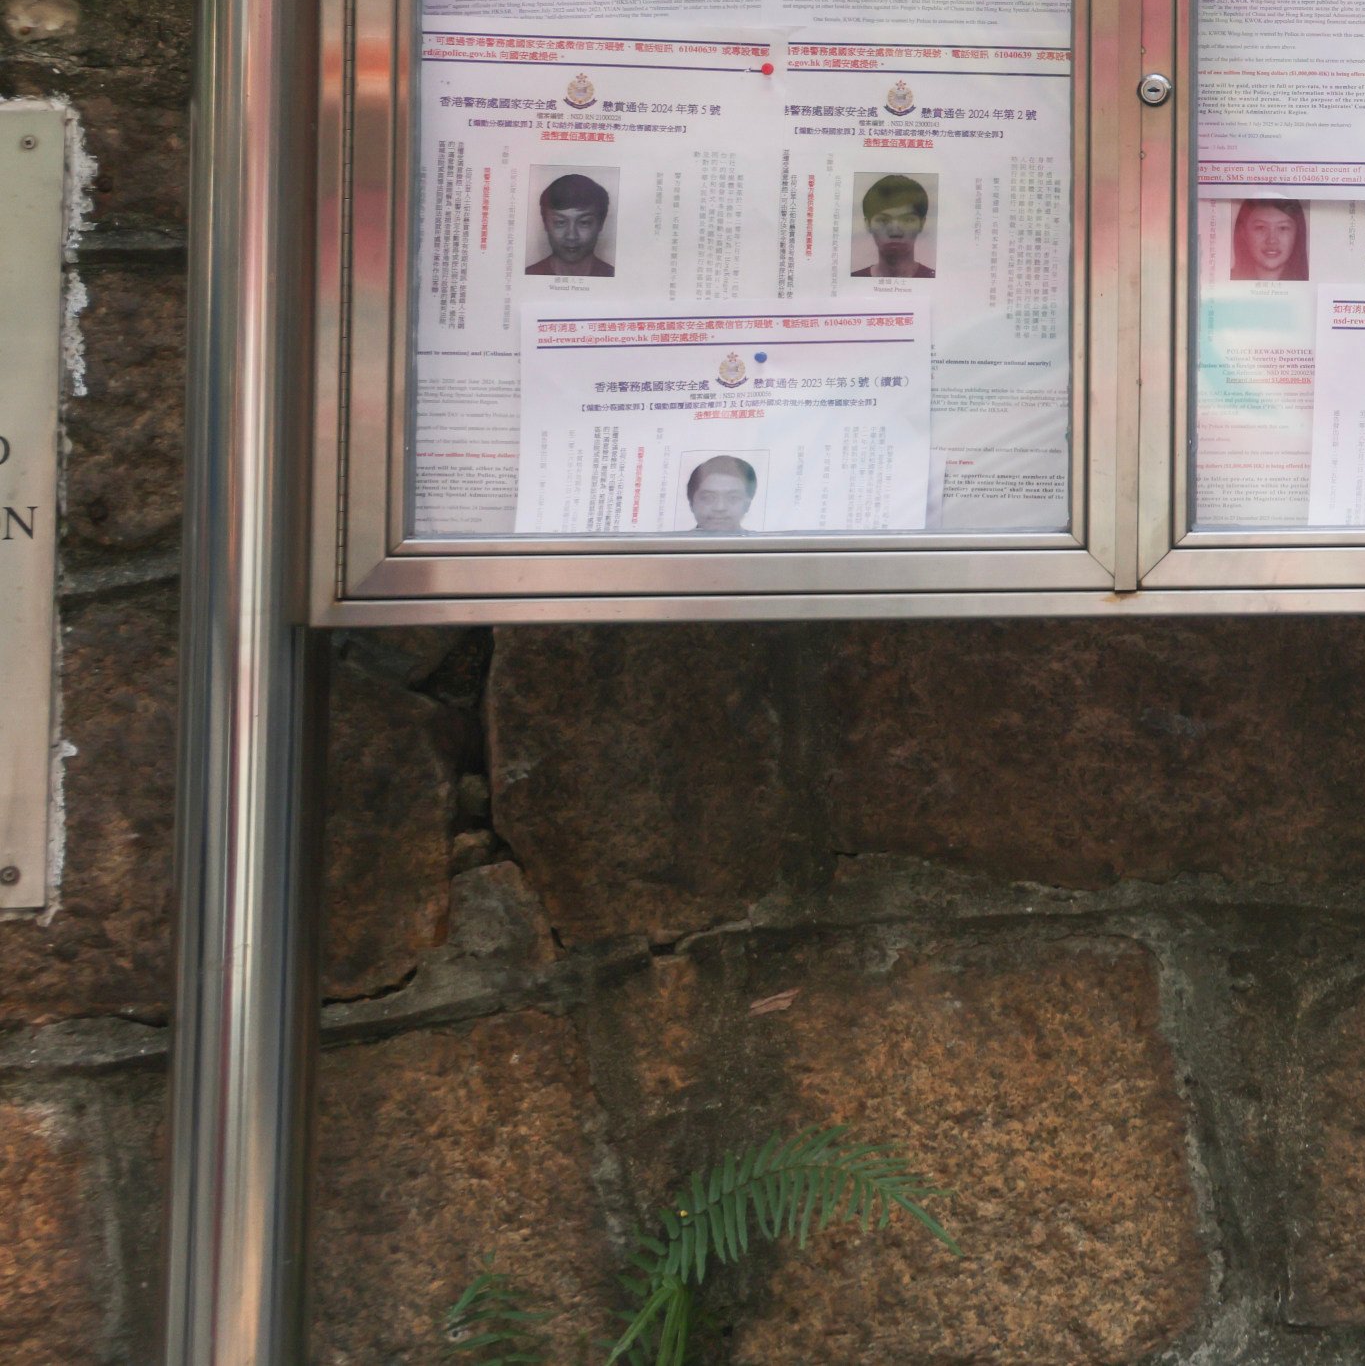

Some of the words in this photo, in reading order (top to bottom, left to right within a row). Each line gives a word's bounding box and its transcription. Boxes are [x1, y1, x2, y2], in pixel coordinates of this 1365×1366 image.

[440, 97, 557, 110] 香港警務處國家安全處
[603, 101, 648, 112] 懸賞通告
[651, 104, 673, 113] 2024
[676, 104, 698, 114] 年第
[701, 105, 706, 114] 5
[710, 105, 720, 115] 號
[921, 108, 965, 118] 懸賞通告
[969, 109, 989, 118] 2024
[993, 109, 1014, 119] 年第
[1018, 111, 1023, 119] 2
[1026, 110, 1036, 120] 號
[1225, 166, 1243, 174] given
[1247, 175, 1277, 184] message
[1279, 175, 1290, 183] via
[1293, 175, 1329, 183] 61040639
[538, 335, 648, 344] nsd-reward@police.gov.hk
[595, 380, 709, 393] 香港警務處國家安全處
[754, 378, 798, 388] 懸賞通告
[801, 378, 822, 387] 2023
[825, 377, 847, 387] 年第
[850, 378, 855, 387] 5
